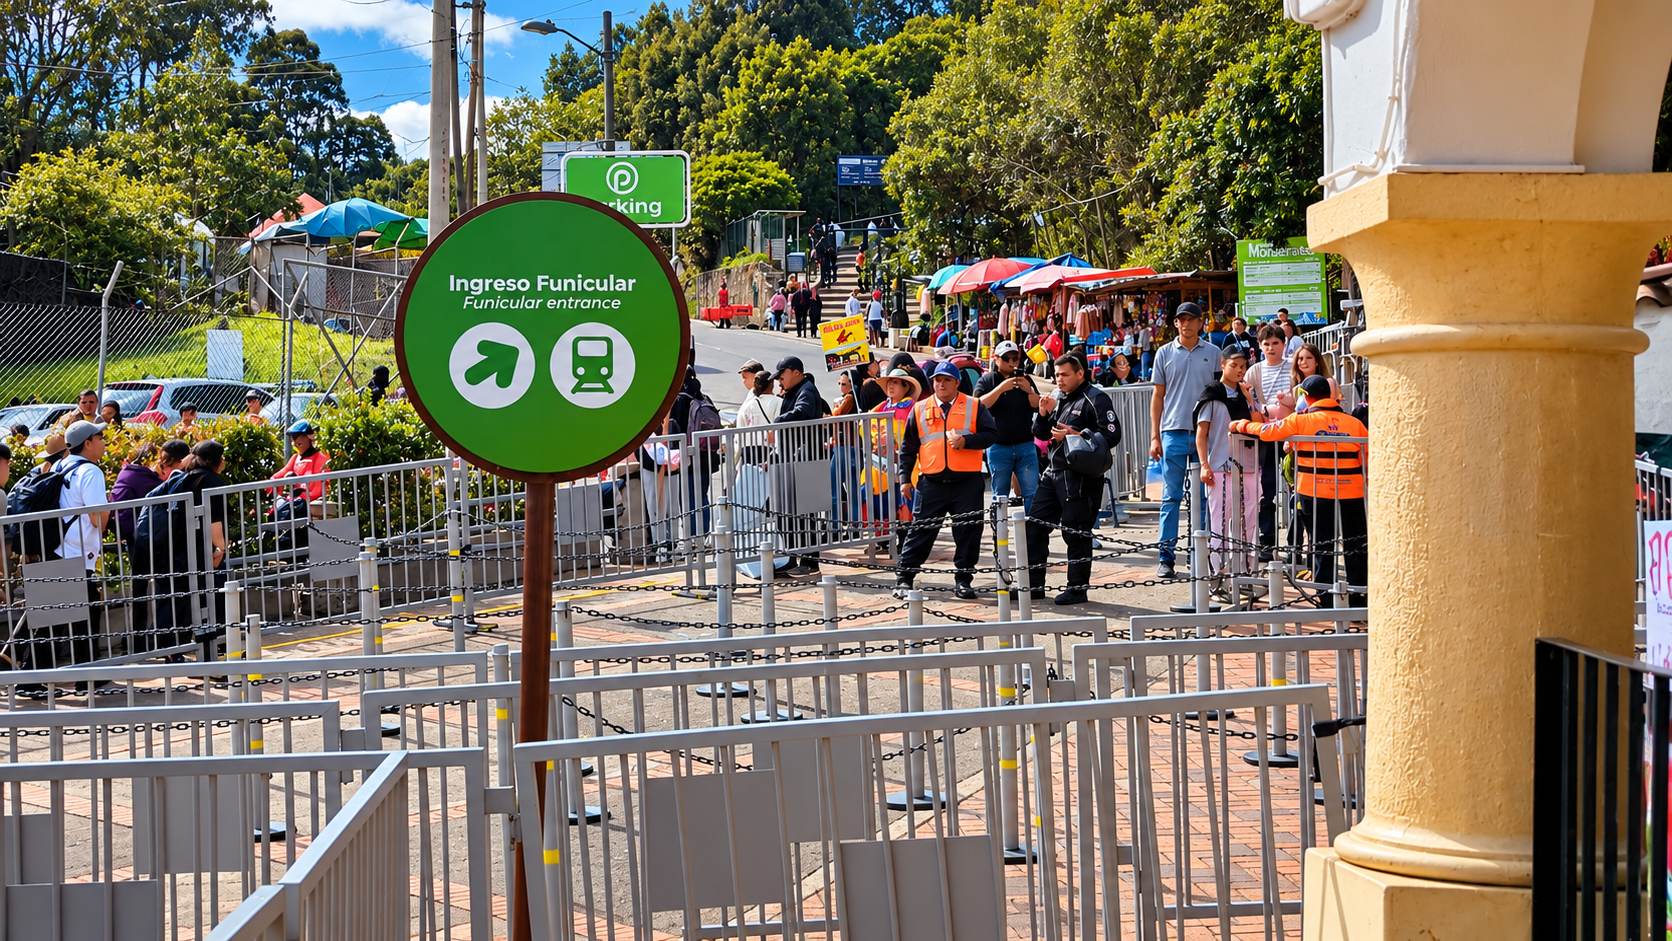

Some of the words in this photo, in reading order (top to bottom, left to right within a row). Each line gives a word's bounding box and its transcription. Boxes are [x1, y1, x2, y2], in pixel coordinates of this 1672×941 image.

[449, 274, 531, 295] Ingreso
[536, 274, 637, 292] Funicular
[463, 295, 543, 309] Funicular
[546, 296, 621, 309] entrance
